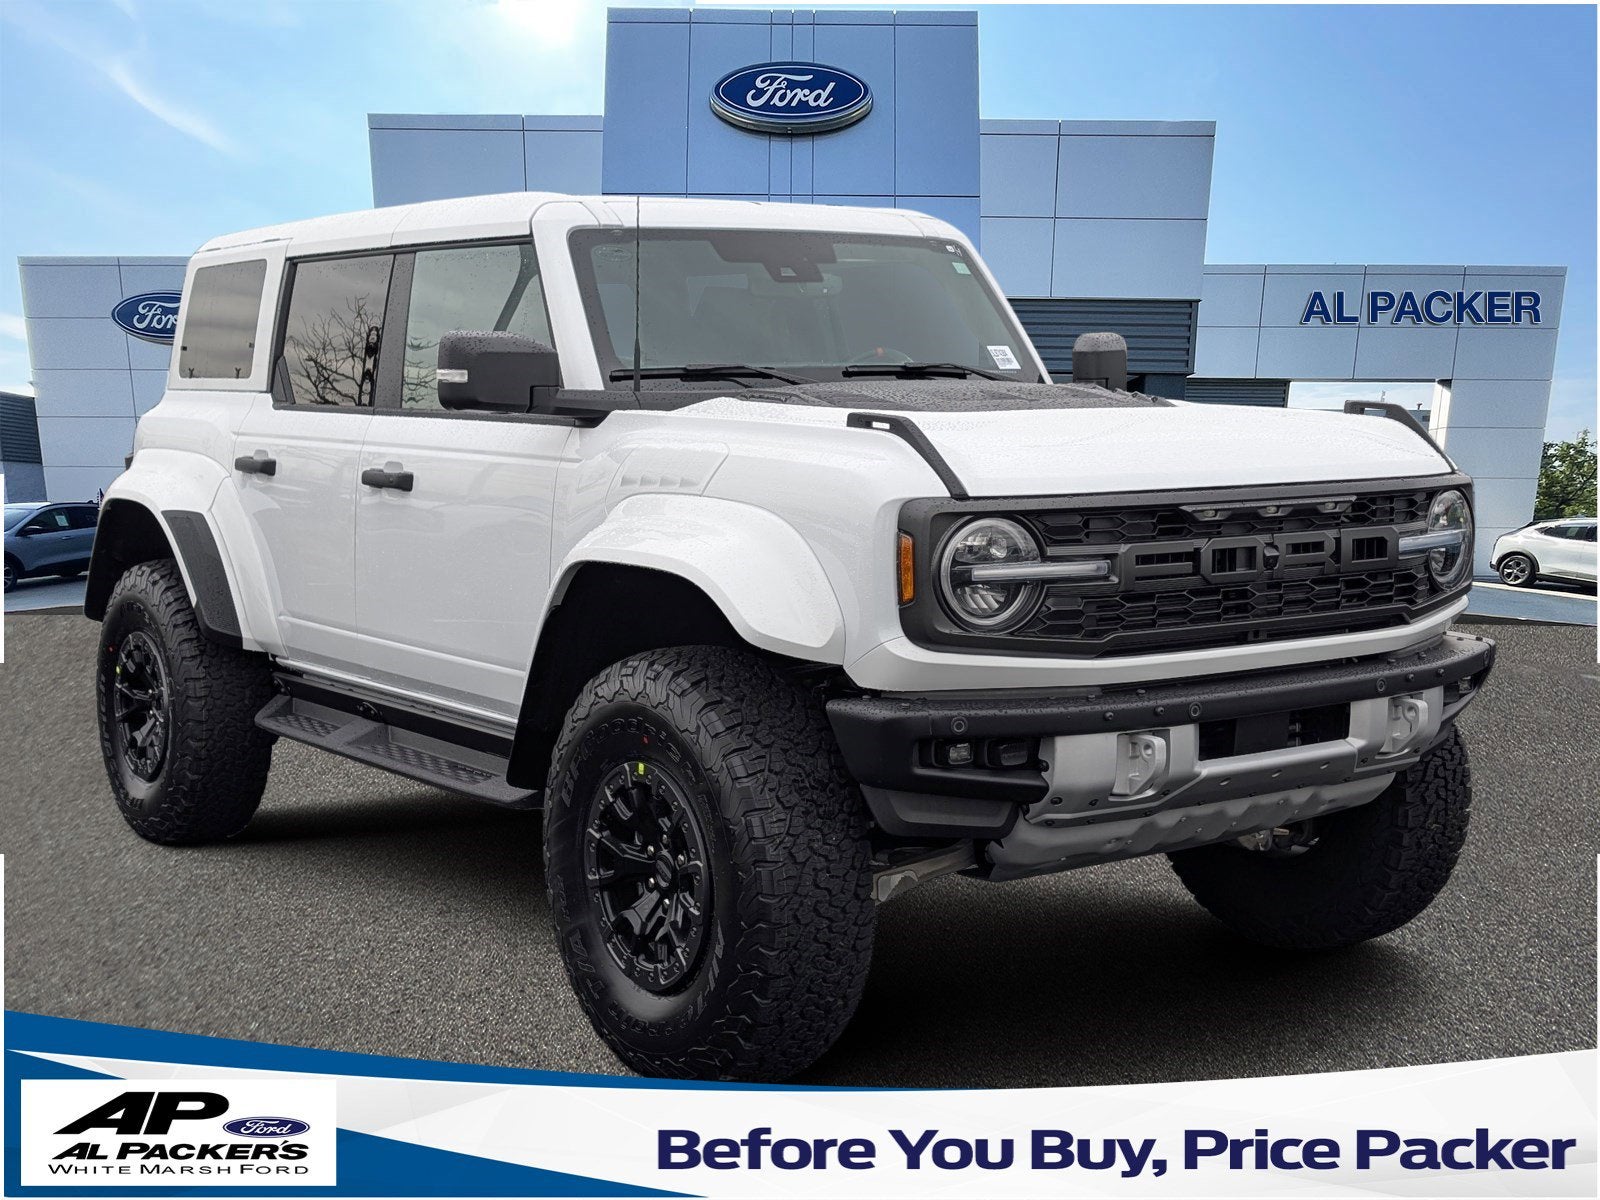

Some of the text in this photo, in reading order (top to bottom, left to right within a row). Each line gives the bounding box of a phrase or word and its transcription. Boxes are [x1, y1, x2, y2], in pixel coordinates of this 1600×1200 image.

[746, 73, 836, 108] Ford
[133, 301, 181, 329] For
[1302, 289, 1543, 324] AL PACKER
[1121, 526, 1399, 592] FORD
